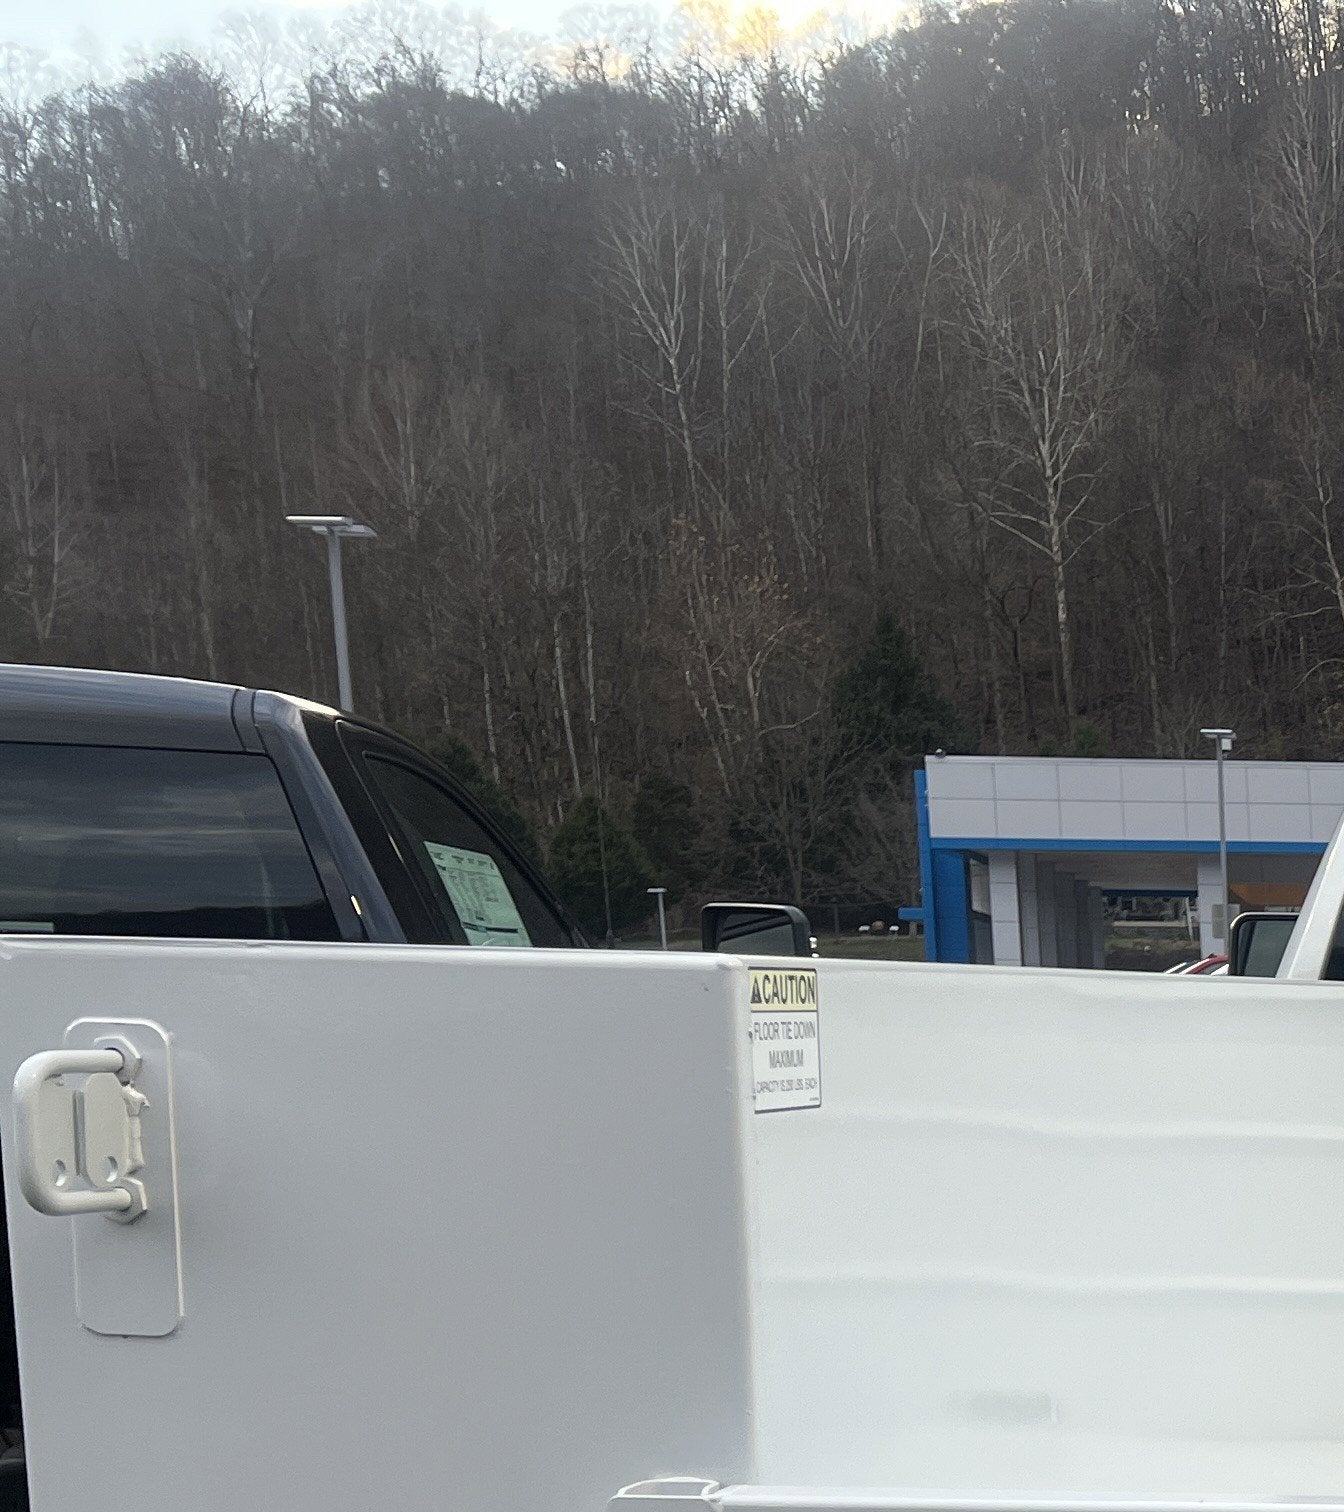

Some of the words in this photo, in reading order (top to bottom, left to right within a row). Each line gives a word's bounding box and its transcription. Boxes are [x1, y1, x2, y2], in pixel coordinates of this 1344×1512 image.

[762, 974, 816, 1004] CAUTION
[754, 1021, 780, 1040] FLOOR
[781, 1021, 792, 1039] TIE
[794, 1021, 816, 1039] DOWN
[769, 1049, 804, 1069] MAXIMUM
